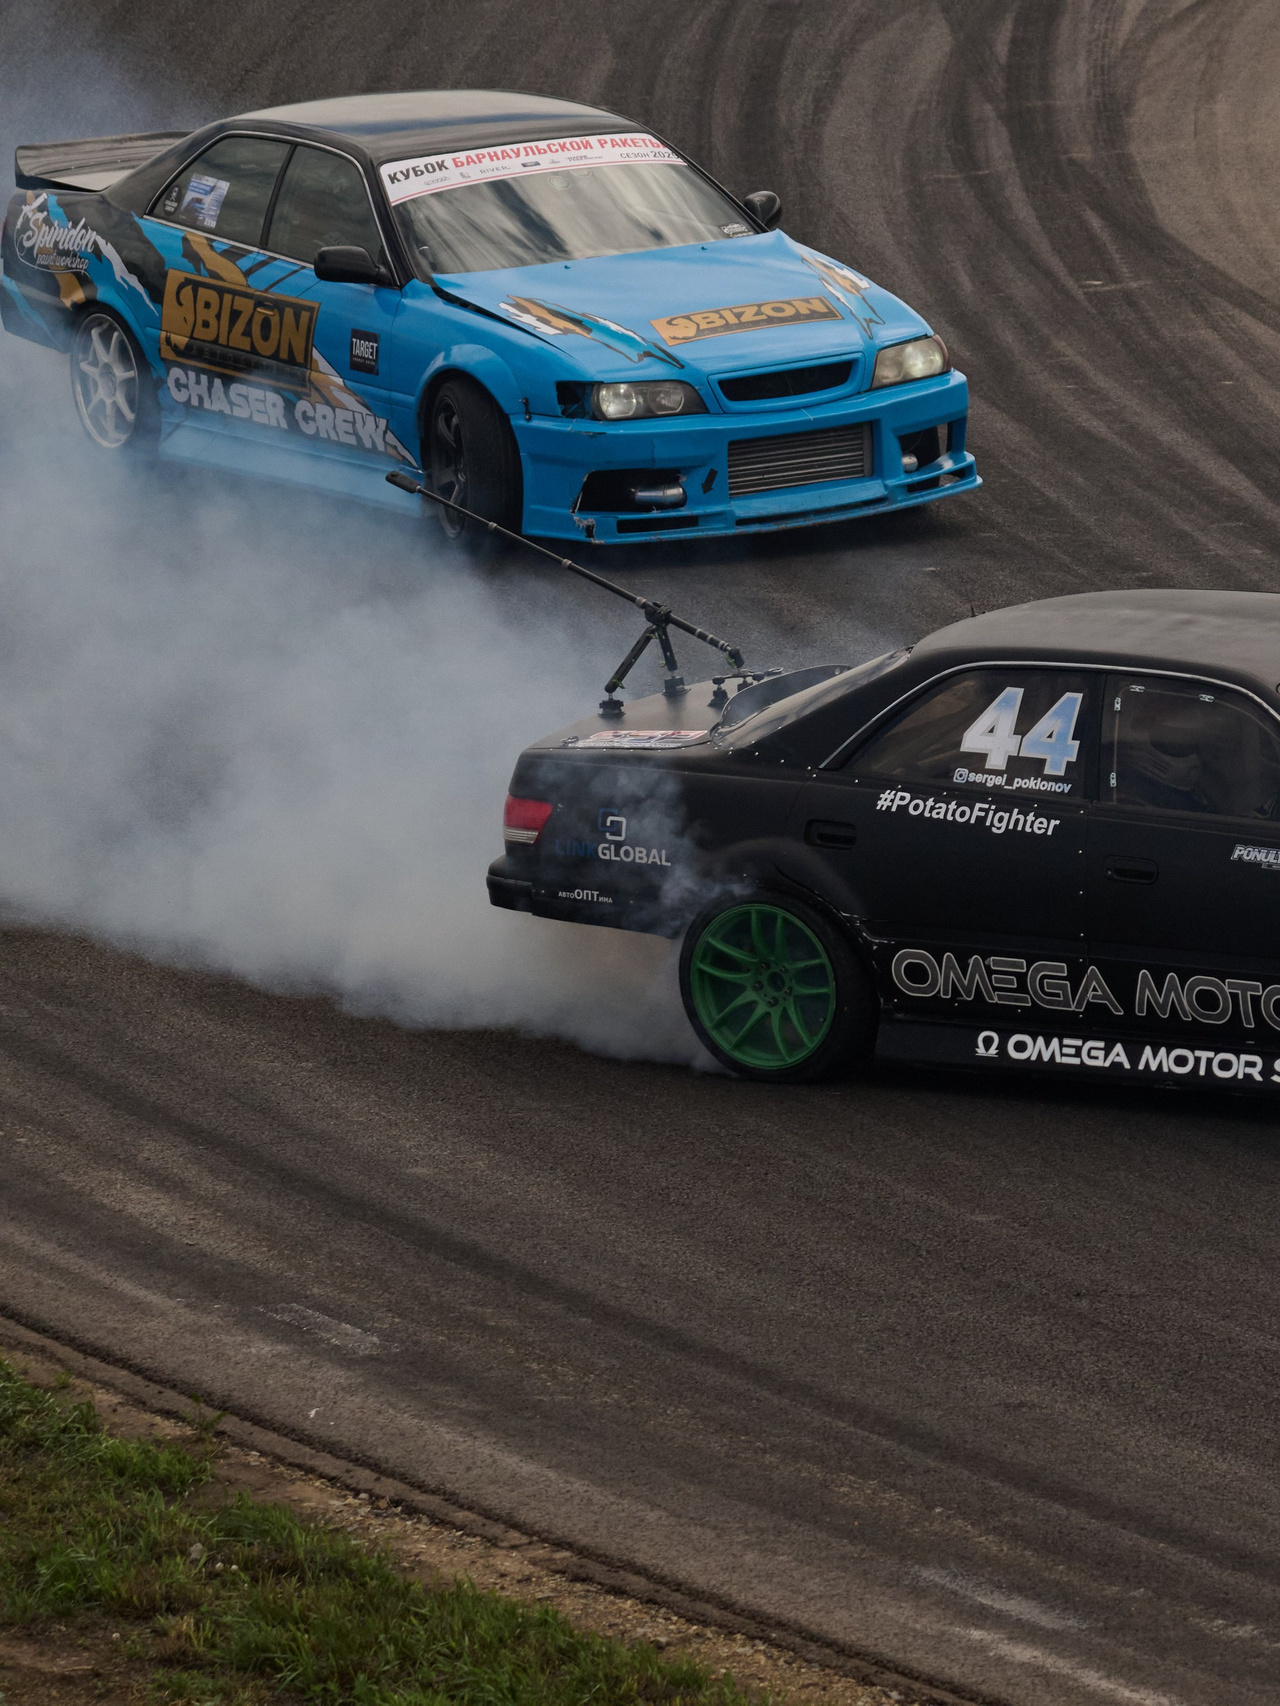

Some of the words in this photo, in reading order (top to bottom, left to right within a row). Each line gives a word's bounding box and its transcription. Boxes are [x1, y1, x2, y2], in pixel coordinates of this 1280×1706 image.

[388, 160, 449, 184] КУБОК
[451, 138, 593, 168] БАРНАУЛЬСКОЙ
[22, 212, 97, 258] Spiridon
[193, 286, 311, 363] BIZON
[689, 299, 830, 330] BIZON
[352, 338, 378, 359] TARGET
[167, 367, 288, 429] CHASER
[295, 400, 388, 452] CREW
[960, 686, 1083, 776] 44
[876, 790, 1060, 835] #PotatoFighter
[892, 949, 1124, 1015] OMEGA
[1007, 1034, 1130, 1069] OMEGA
[1138, 1045, 1263, 1082] MOTOR
